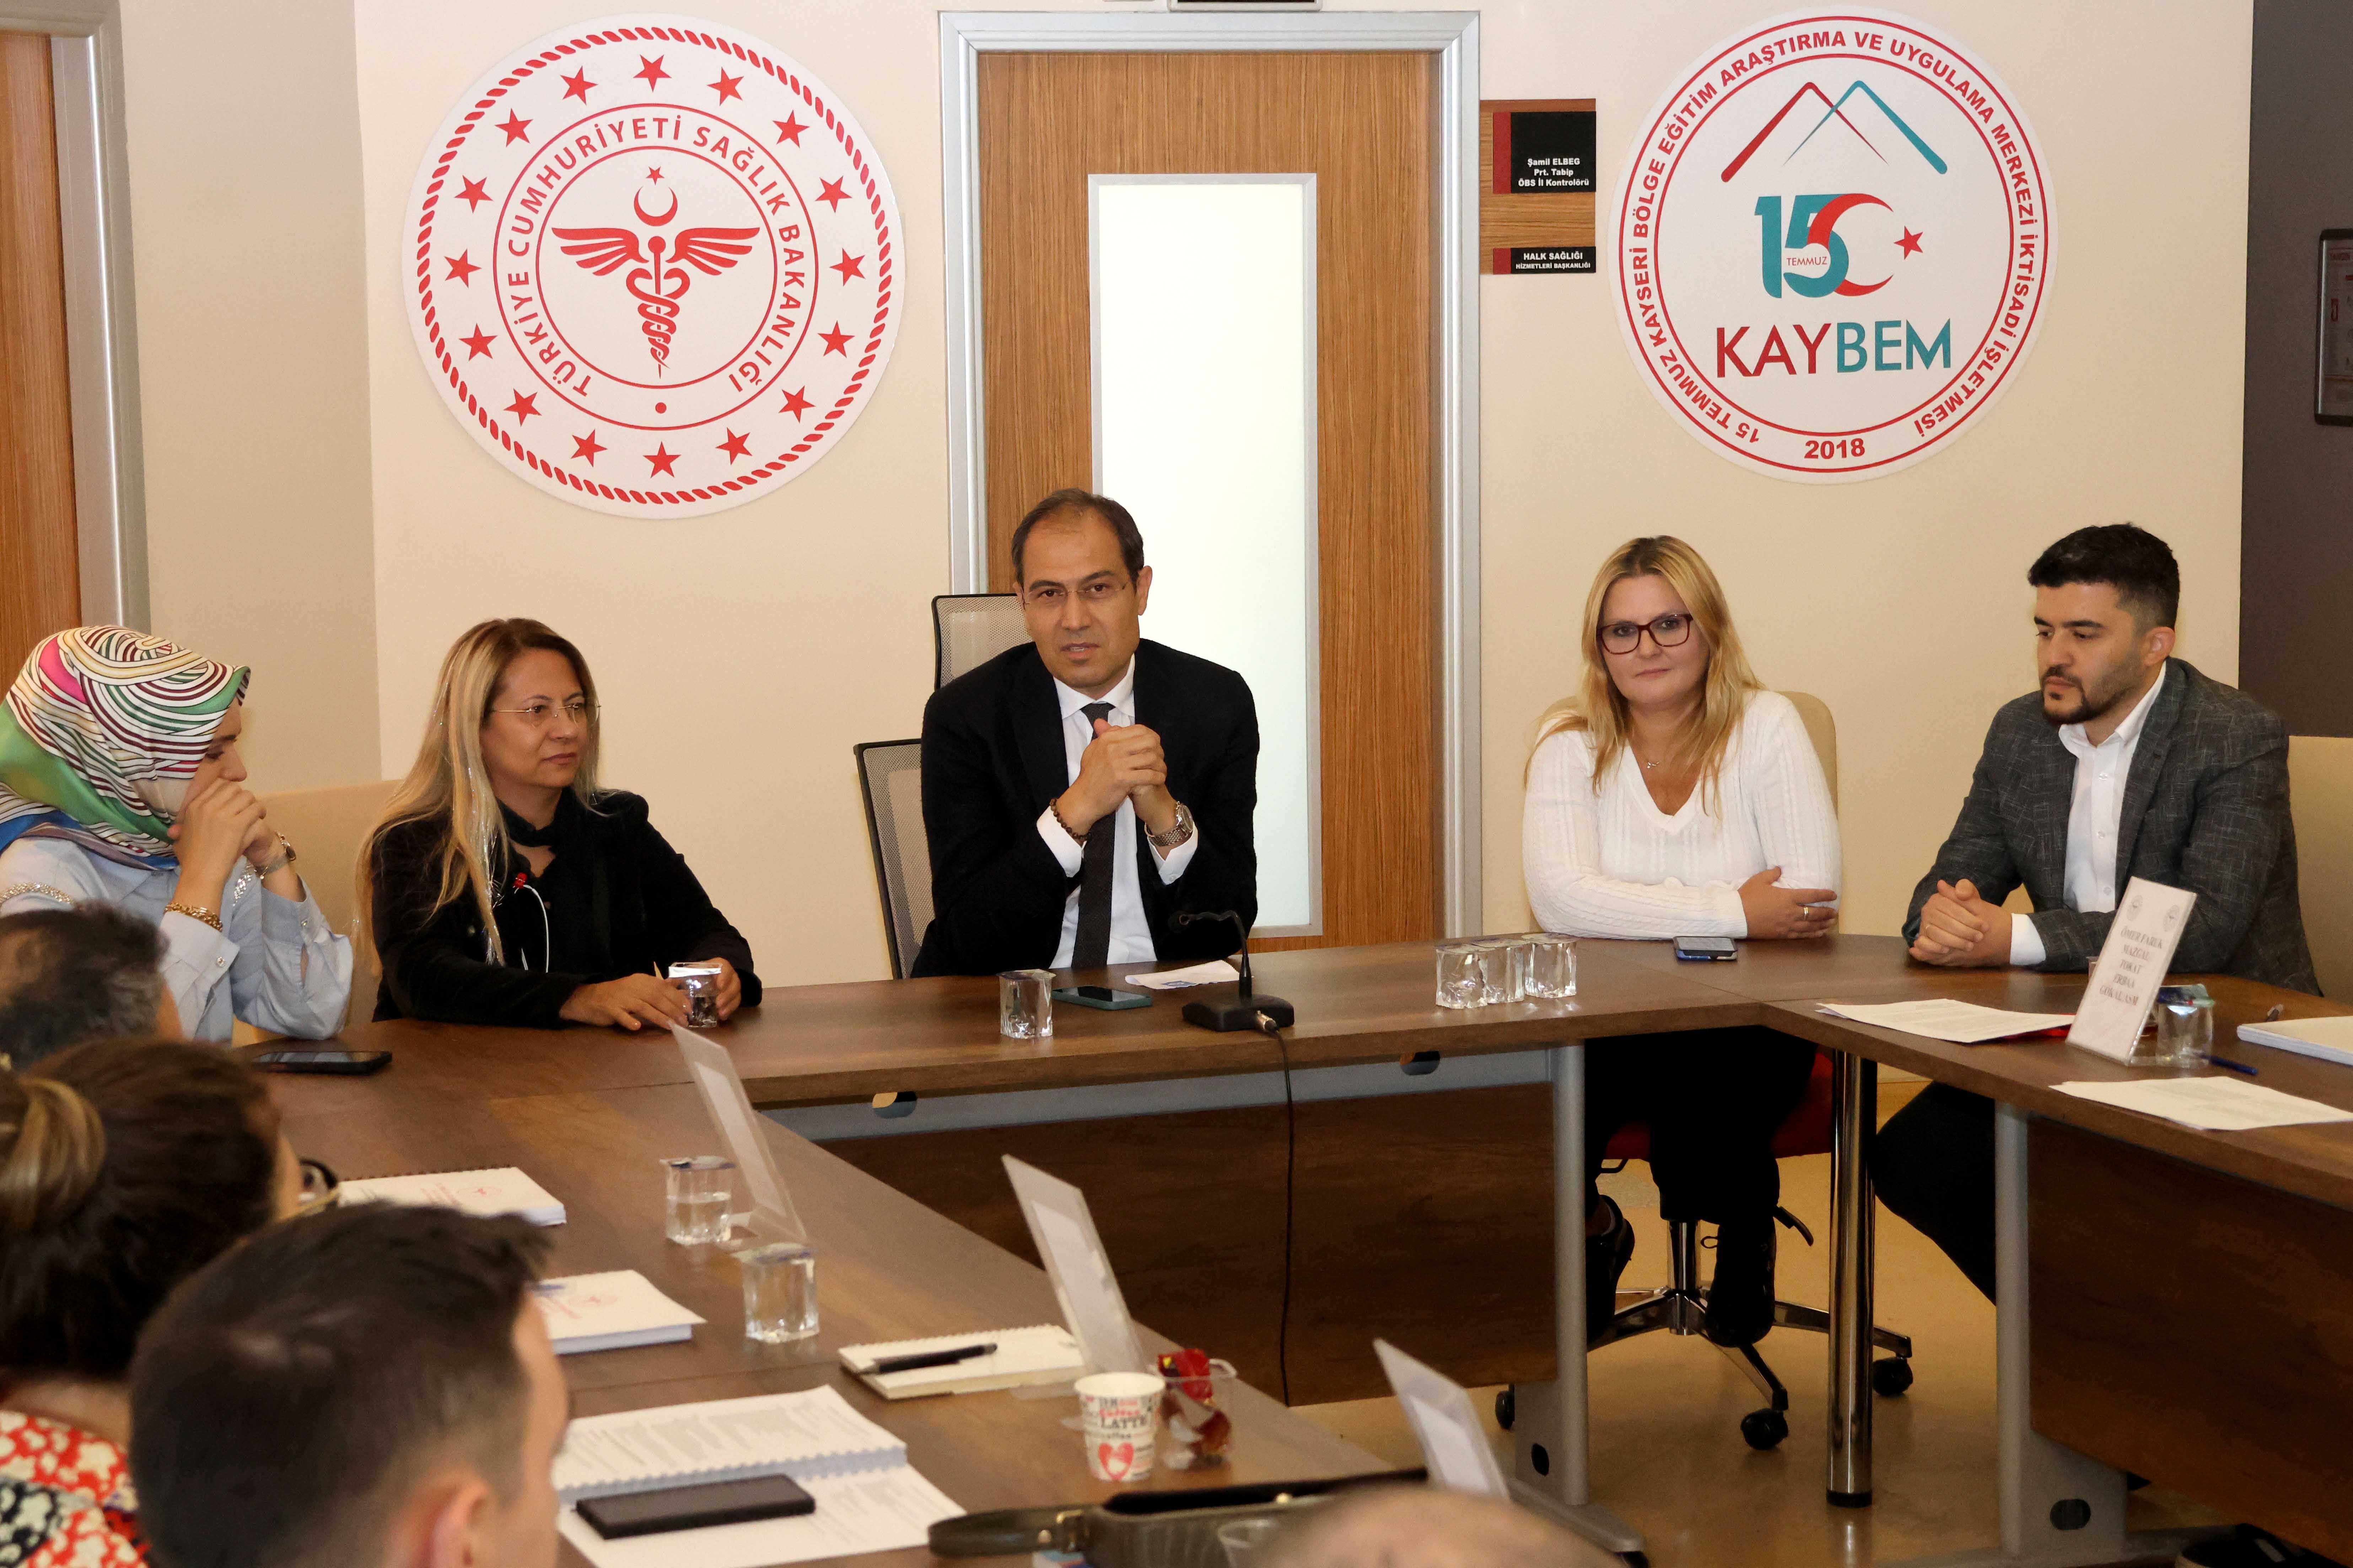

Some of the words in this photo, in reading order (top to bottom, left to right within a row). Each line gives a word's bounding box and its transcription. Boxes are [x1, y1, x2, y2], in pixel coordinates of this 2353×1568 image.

[1721, 31, 1846, 87] ARAŞTIRMA
[1854, 31, 1883, 51] VE
[1890, 39, 1994, 124] UYGULAMA
[1658, 82, 1717, 155] EĞİTİM
[508, 115, 681, 257] CUMHURİYETİ
[693, 126, 790, 215] SAĞLIK
[1518, 178, 1535, 186] ÖBS
[1538, 178, 1543, 186] İl
[1546, 177, 1589, 186] Kontrolörü
[1527, 158, 1550, 167] Şamil
[1551, 168, 1573, 177] Tabip
[1991, 123, 2038, 225] MERKEZİ
[1633, 158, 1665, 238] BÖLGE
[1549, 251, 1583, 260] SAĞLIĞI
[1554, 261, 1590, 270] BAŞKANLIĞI
[1787, 256, 1827, 266] TEMMUZ
[2000, 234, 2039, 337] İKTİSADİ
[729, 224, 805, 392] BAKANLIĞI
[1630, 248, 1667, 347] KAYSERİ
[508, 271, 591, 396] TÜRKİYE
[1717, 318, 1951, 378] KAYBEM
[1660, 349, 1731, 429] TEMMUZ
[1914, 340, 2009, 437] İŞLETMESİ
[1735, 422, 1759, 443] 15
[1804, 438, 1865, 460] 2018
[1101, 1415, 1147, 1429] LATTE
